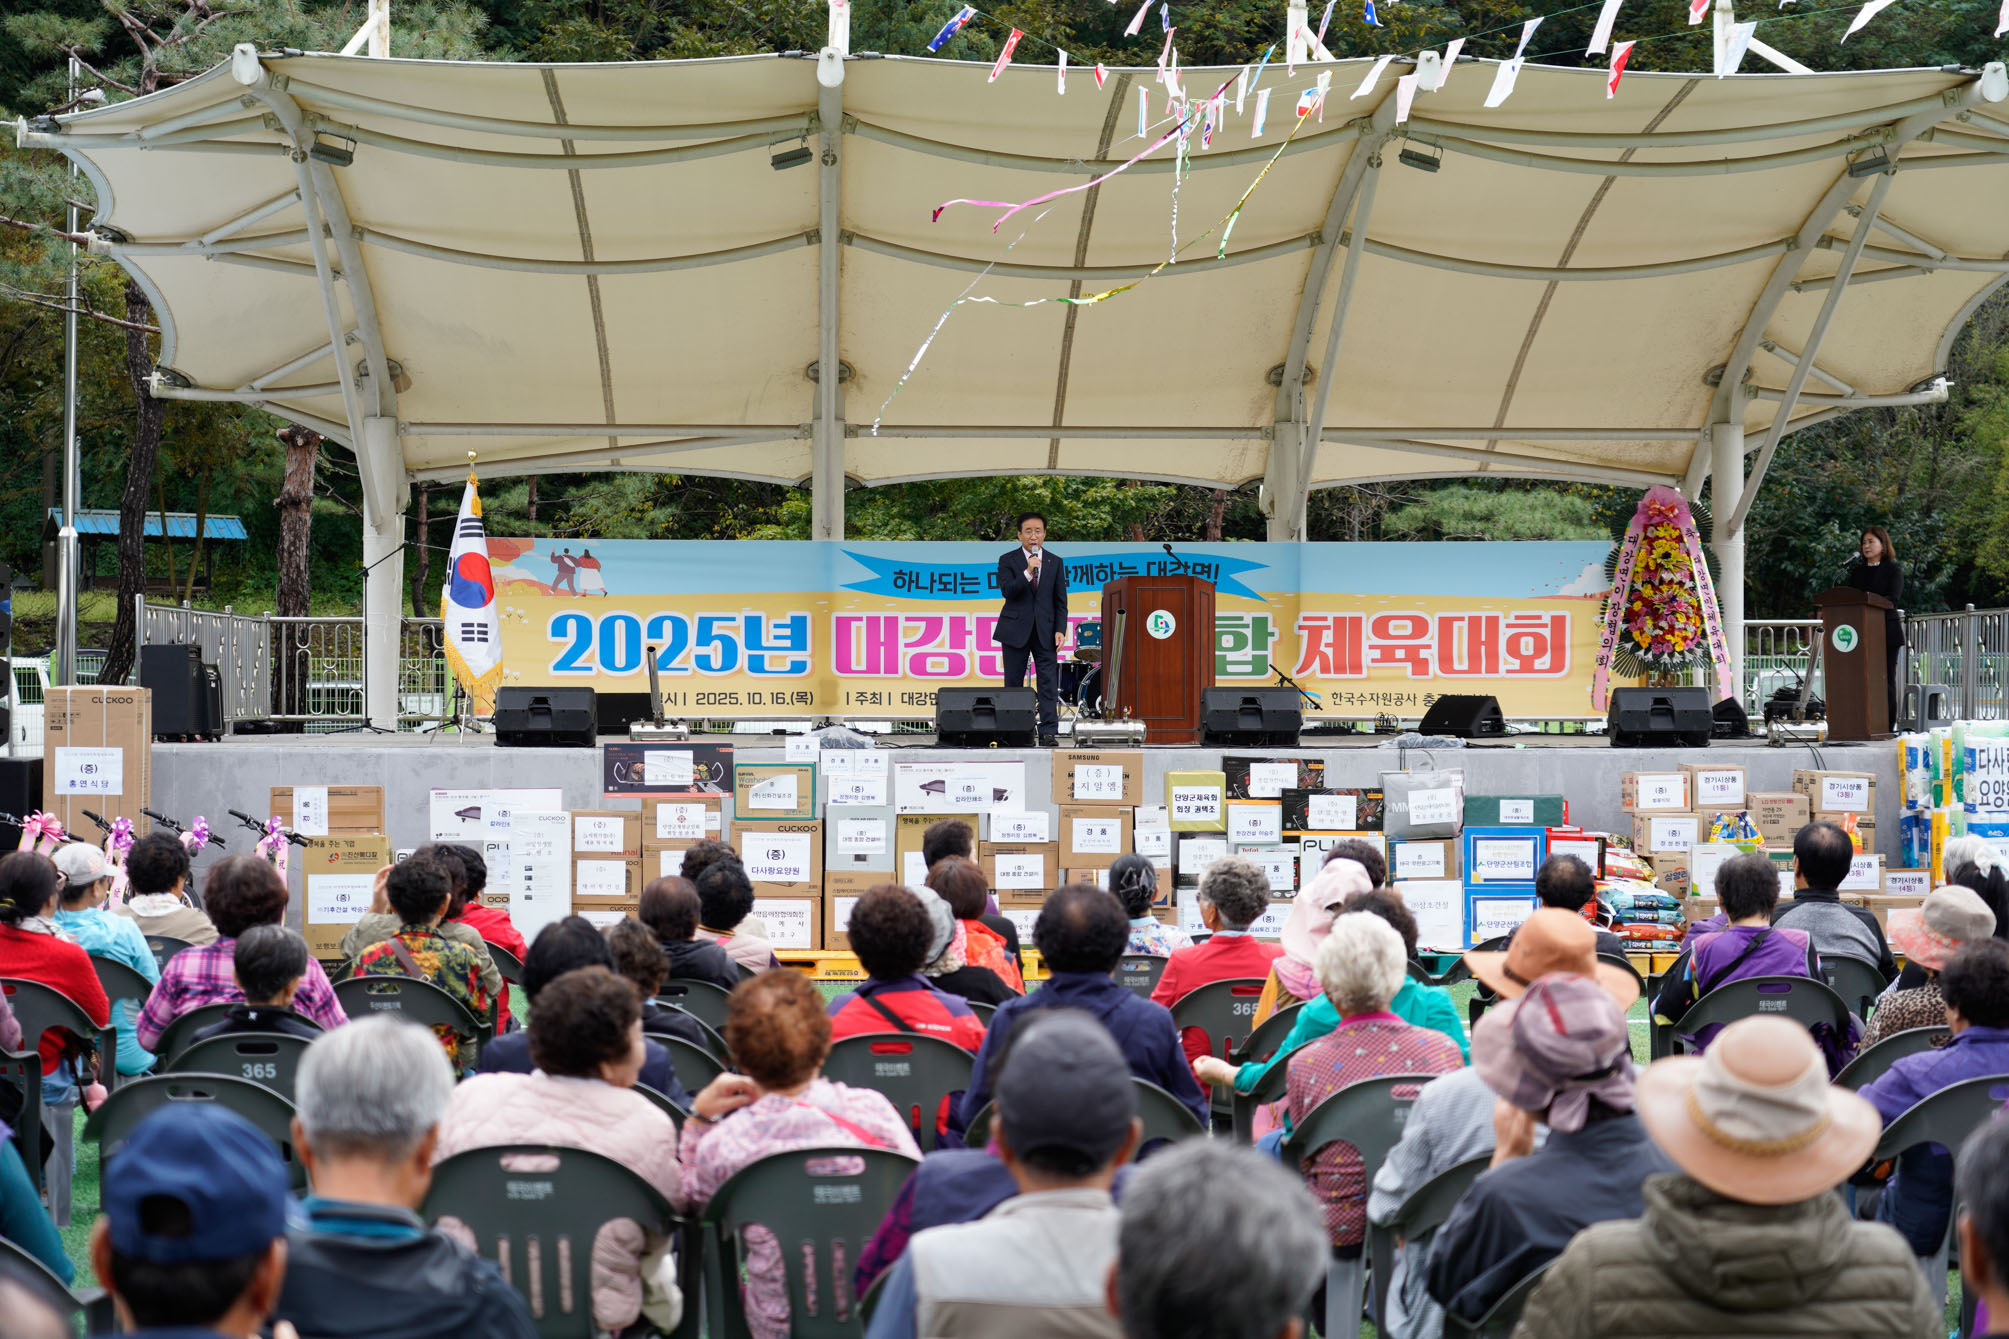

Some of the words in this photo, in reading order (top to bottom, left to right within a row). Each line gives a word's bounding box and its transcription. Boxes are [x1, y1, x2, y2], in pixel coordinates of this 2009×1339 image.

[893, 570, 981, 595] 하나되는
[551, 612, 810, 677] 2025년
[1297, 613, 1567, 677] 체육대회
[855, 692, 882, 706] 주최
[1331, 691, 1417, 707] 한국수자원공사
[1978, 746, 2009, 775] 다사
[1174, 793, 1218, 802] 단양군체육회
[1978, 780, 2009, 809] 요양
[1176, 805, 1191, 814] 회장
[778, 825, 818, 833] CUCKOO
[766, 848, 786, 860] (증)
[752, 866, 800, 876] 다사랑요양원
[242, 1063, 277, 1078] 365
